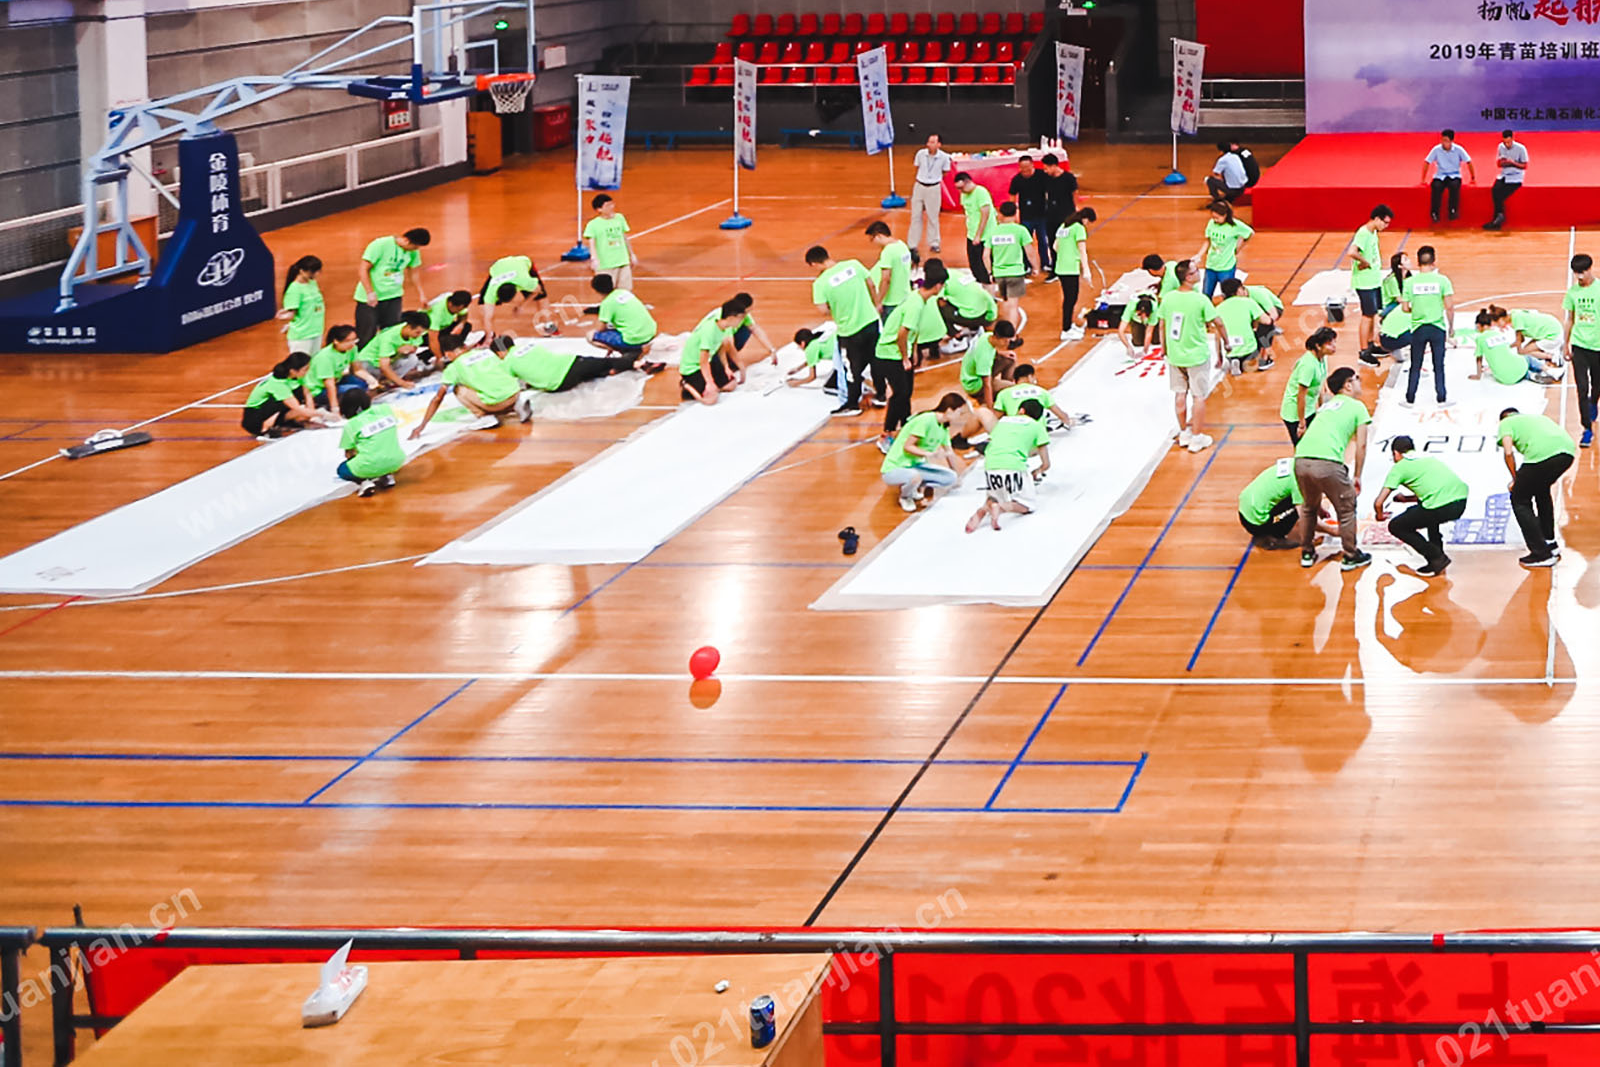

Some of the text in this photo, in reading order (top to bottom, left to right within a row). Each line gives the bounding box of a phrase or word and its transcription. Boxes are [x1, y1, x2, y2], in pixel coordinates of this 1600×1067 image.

[1429, 41, 1600, 61] 2019年青苗培训班
